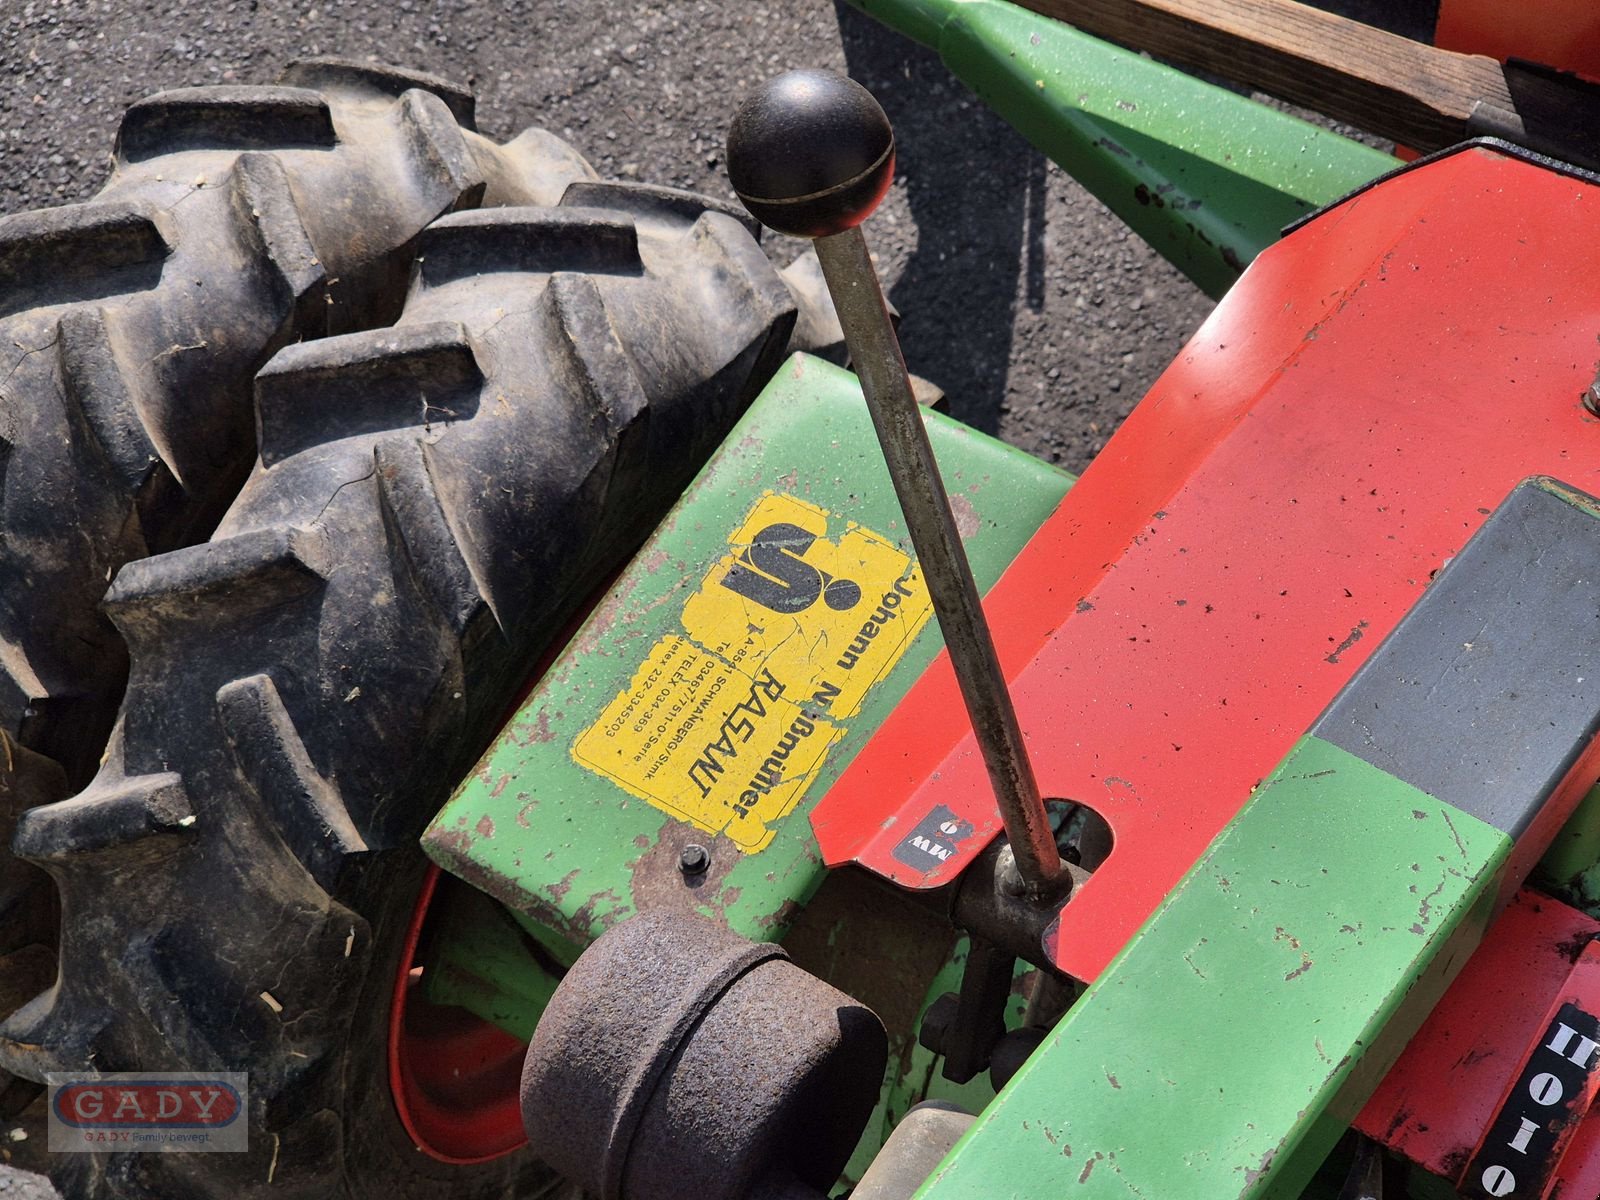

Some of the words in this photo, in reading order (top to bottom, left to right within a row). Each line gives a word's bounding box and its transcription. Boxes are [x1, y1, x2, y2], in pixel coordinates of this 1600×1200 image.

[837, 576, 913, 670] Johann
[659, 631, 693, 667] Teletex
[667, 654, 698, 688] TELEX
[723, 637, 755, 675] A-8541
[605, 668, 662, 738] 232-3345203
[633, 688, 671, 733] 034-369
[642, 675, 727, 781] SCHWANBERG/Stmk.
[688, 666, 787, 800] RASANT
[908, 835, 953, 861] MW
